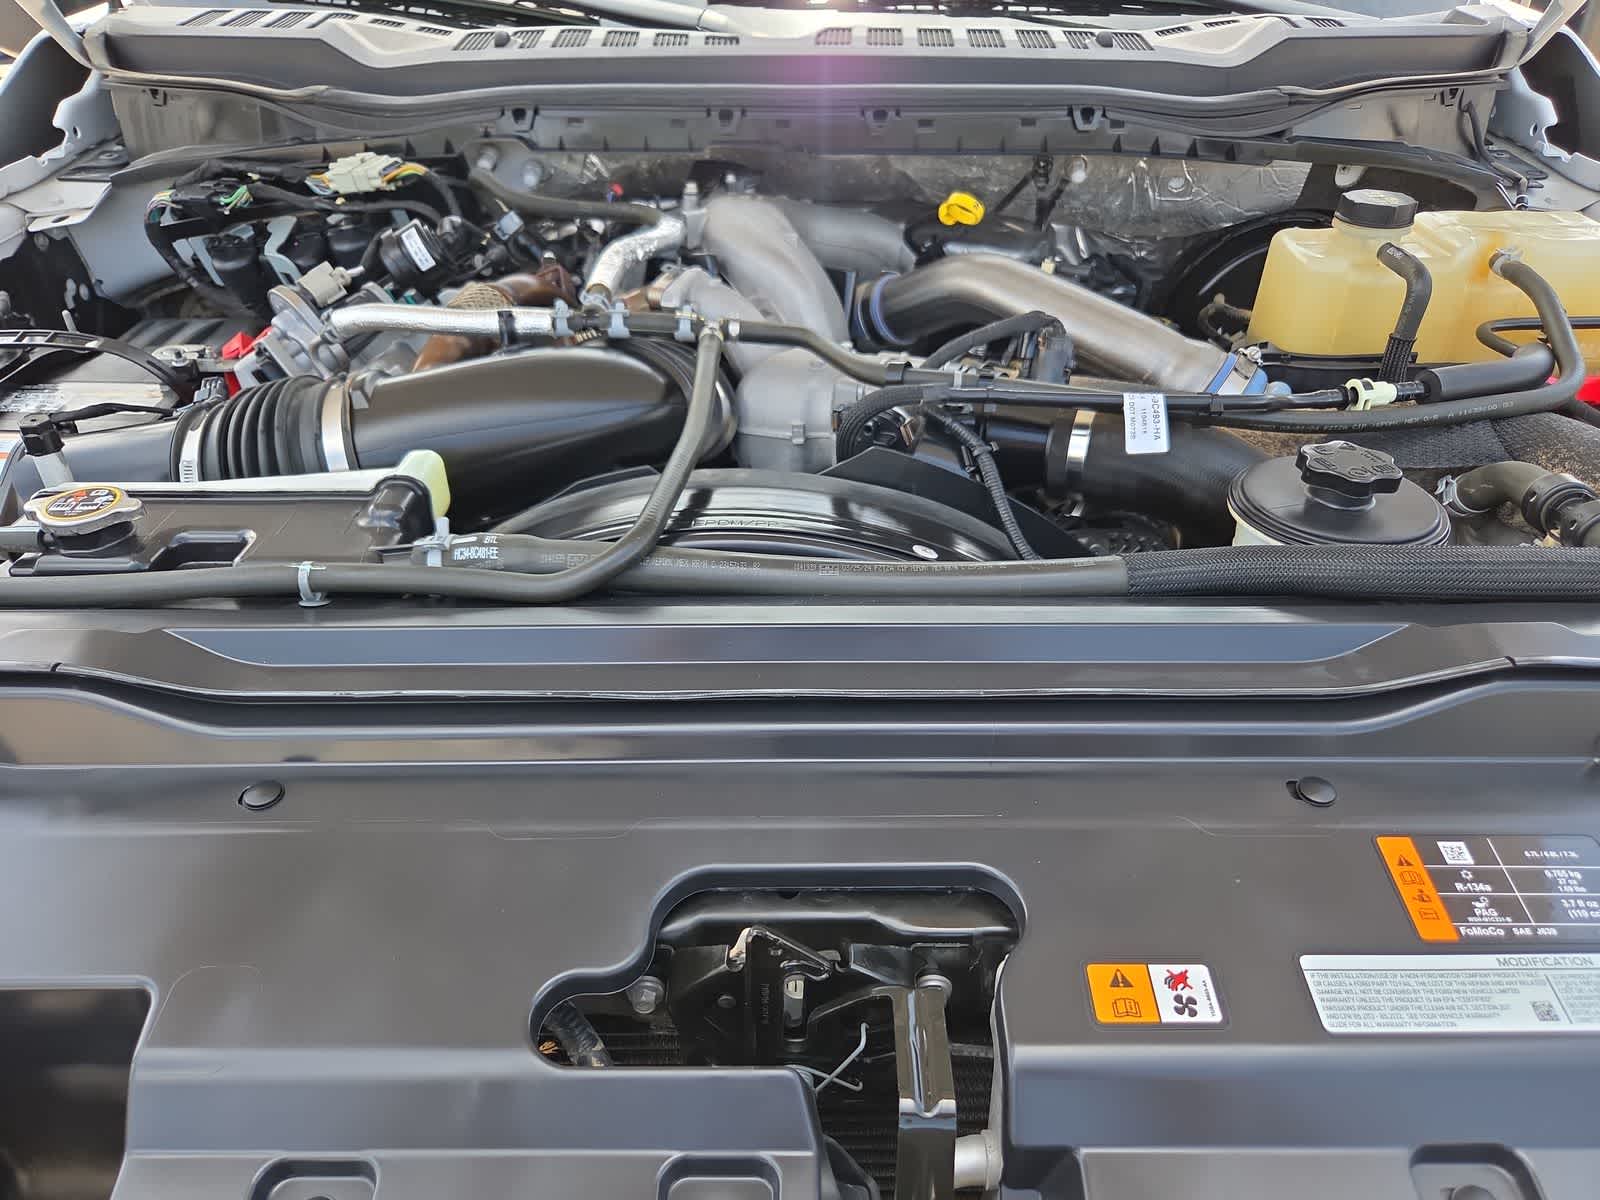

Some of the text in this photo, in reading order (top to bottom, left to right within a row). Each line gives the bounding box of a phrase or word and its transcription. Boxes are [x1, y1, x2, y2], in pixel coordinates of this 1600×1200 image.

[1455, 882, 1493, 893] R-134a
[1474, 907, 1500, 917] PAG
[1459, 926, 1506, 937] FoMoCo
[1512, 927, 1533, 936] SAE
[1495, 956, 1594, 967] MODIFICATION
